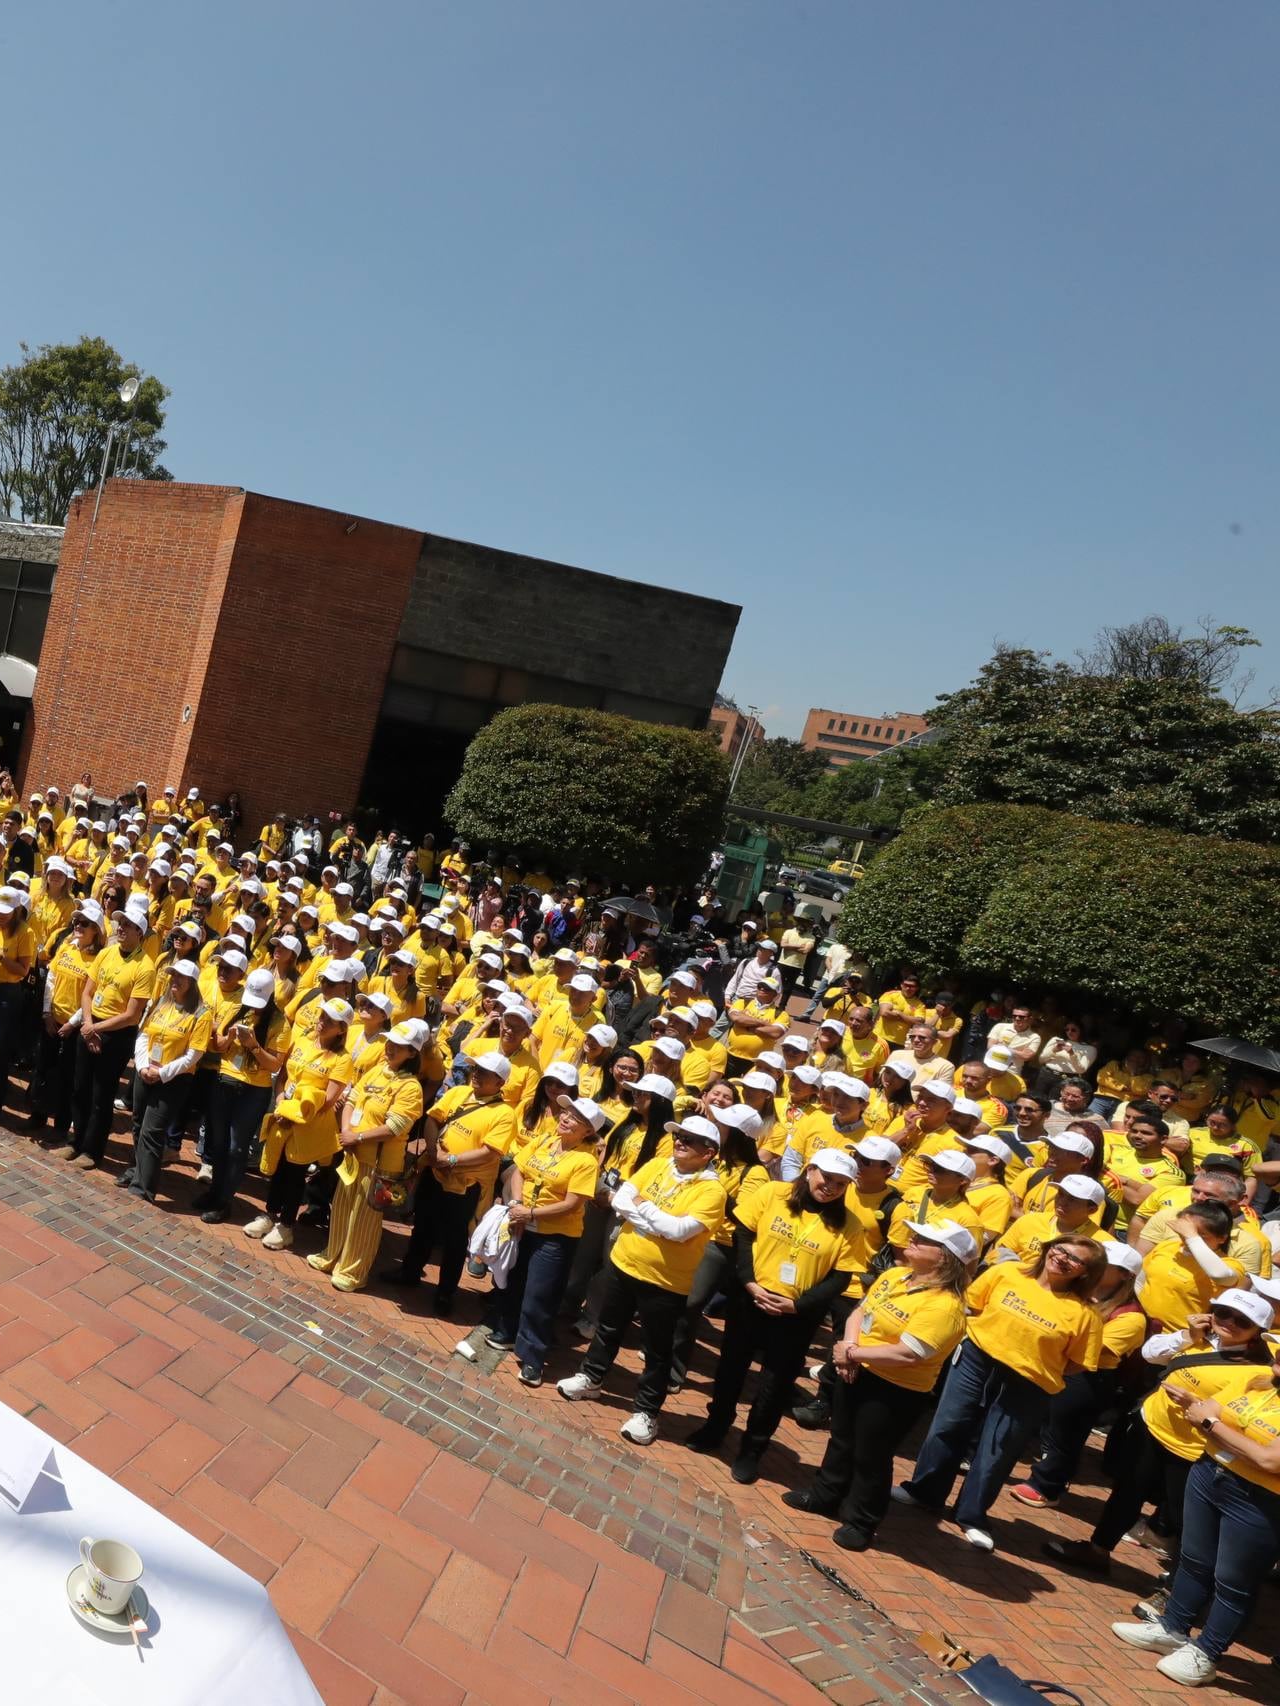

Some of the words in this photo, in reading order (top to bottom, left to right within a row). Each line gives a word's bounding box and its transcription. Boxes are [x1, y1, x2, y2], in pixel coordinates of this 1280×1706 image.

[57, 960, 88, 977] Electora
[774, 1216, 793, 1231] Paz
[770, 1224, 820, 1250] Elecral
[1005, 1290, 1028, 1306] Paz
[1001, 1297, 1057, 1330] Electoral
